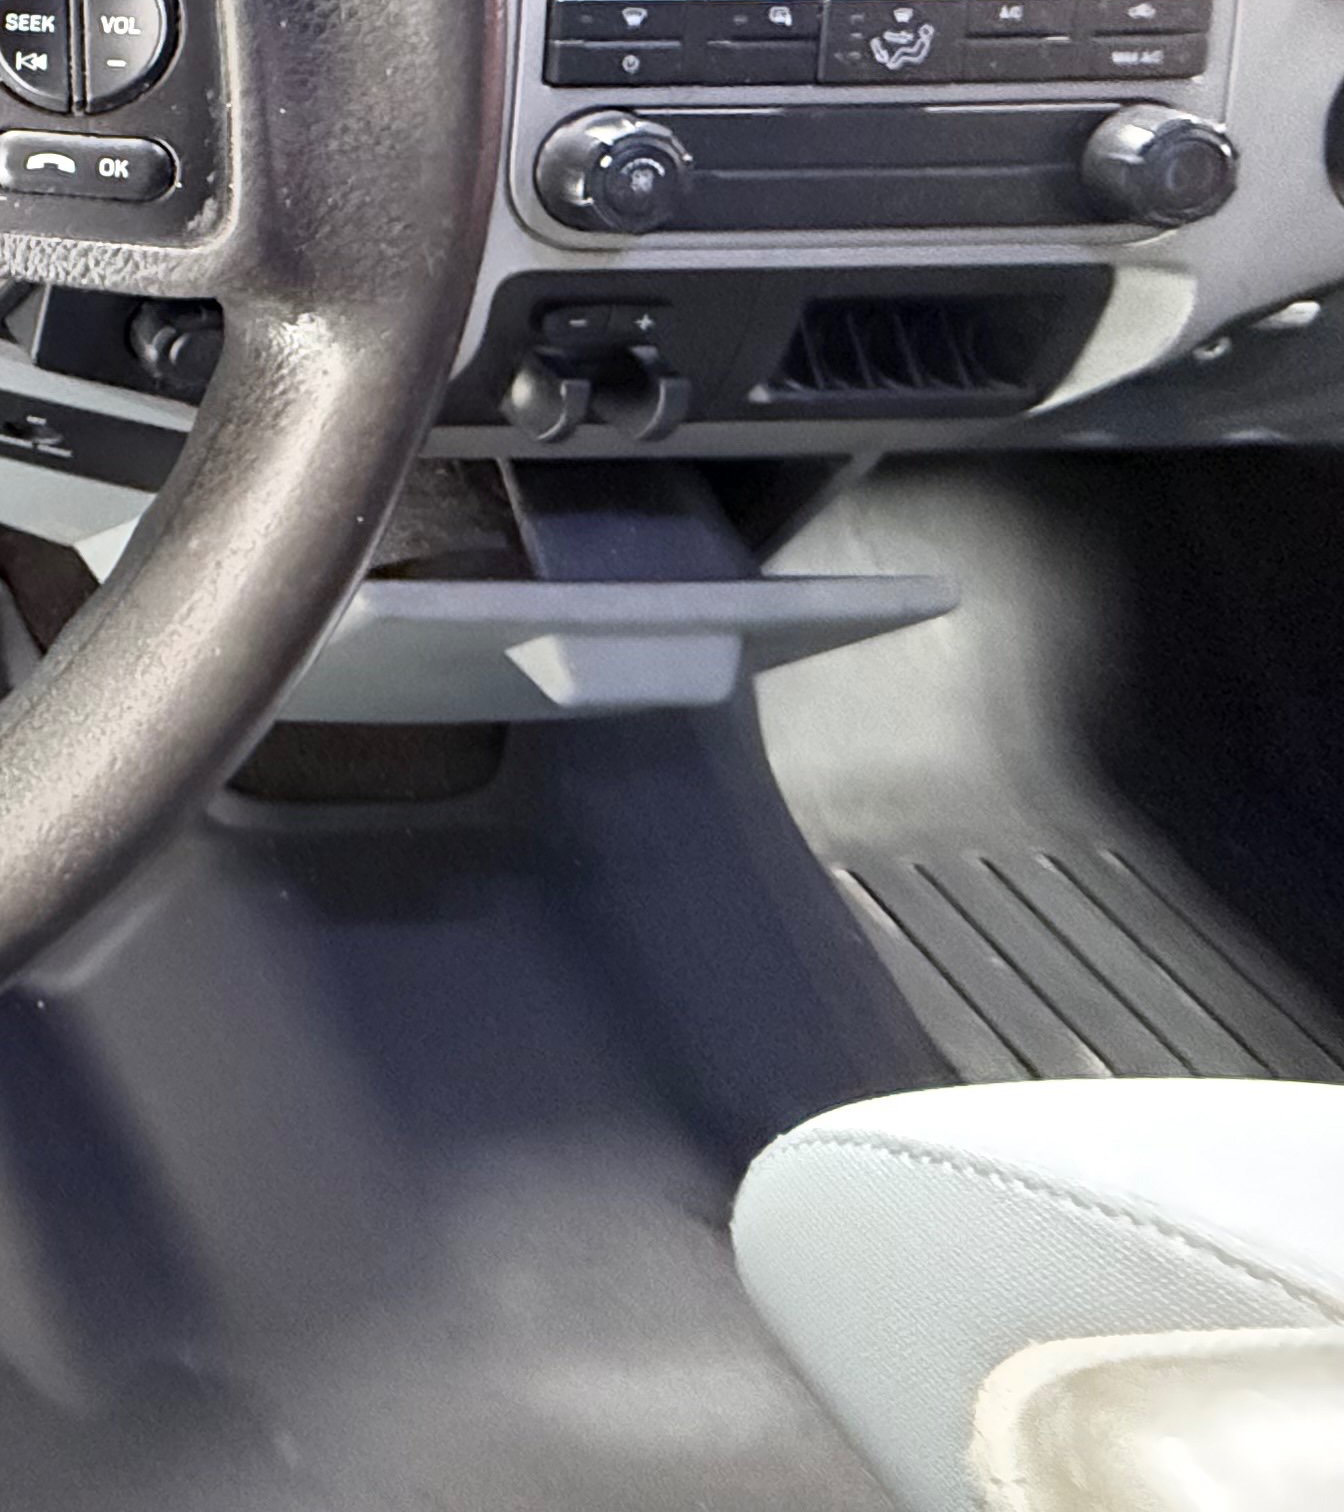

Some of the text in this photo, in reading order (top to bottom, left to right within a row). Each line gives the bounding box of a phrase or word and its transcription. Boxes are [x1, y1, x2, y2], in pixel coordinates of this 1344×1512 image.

[5, 13, 56, 33] SEEK
[101, 16, 141, 35] VOL
[98, 158, 130, 178] OK
